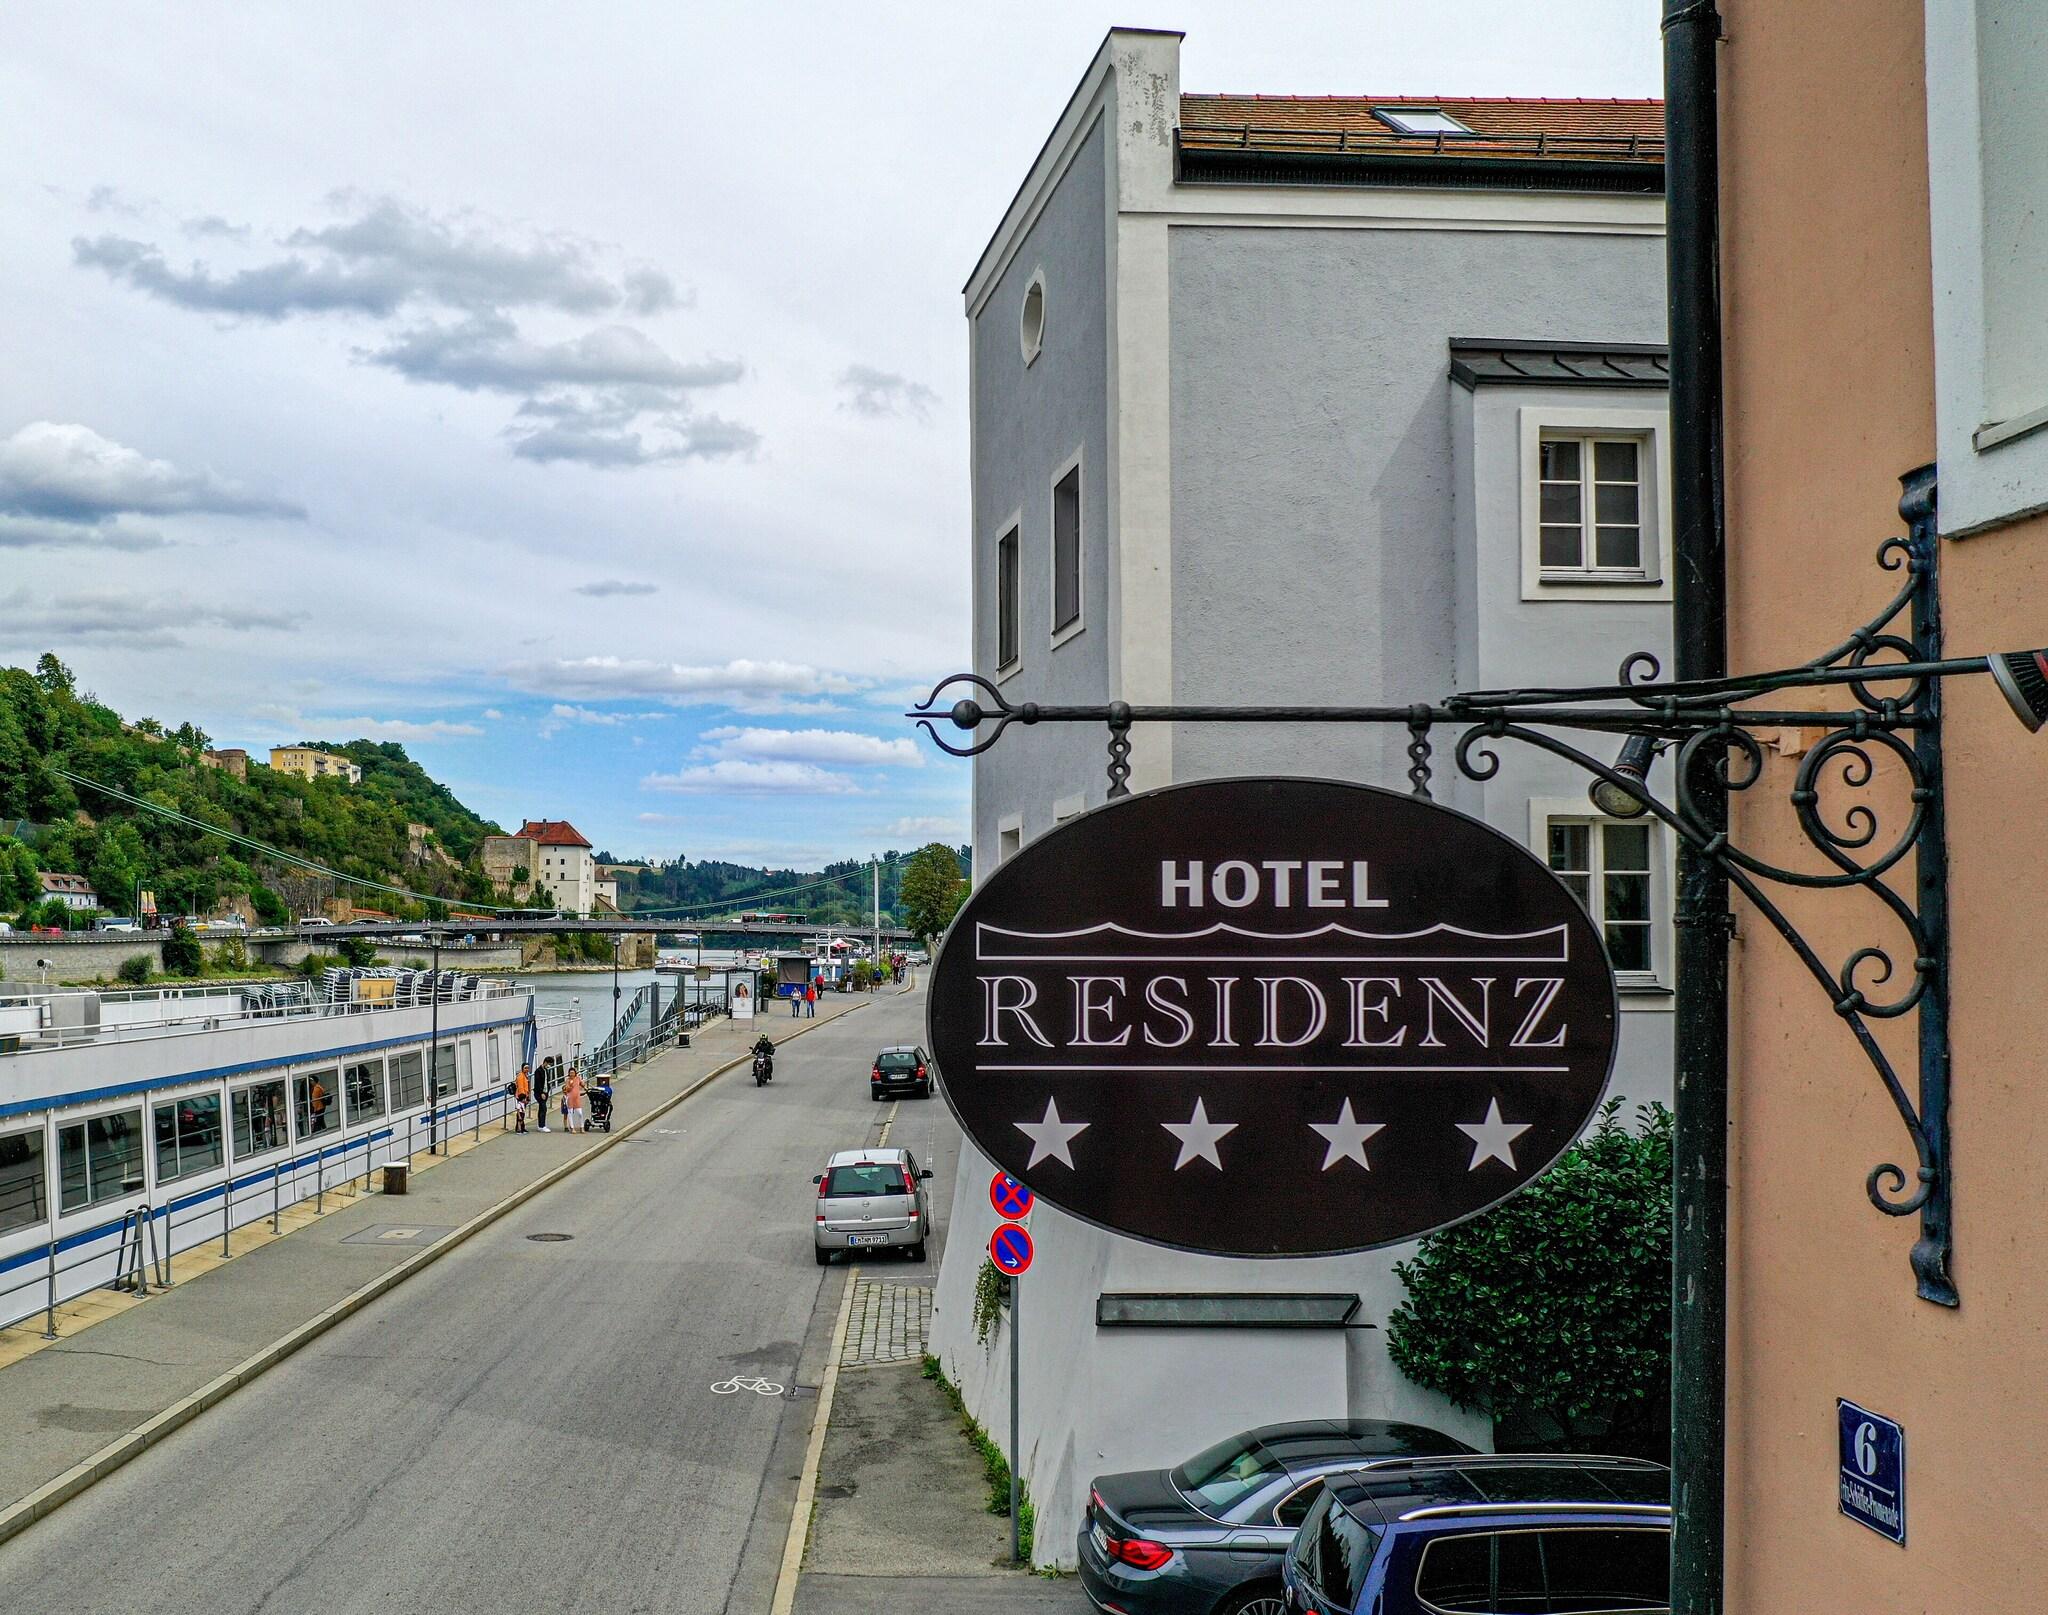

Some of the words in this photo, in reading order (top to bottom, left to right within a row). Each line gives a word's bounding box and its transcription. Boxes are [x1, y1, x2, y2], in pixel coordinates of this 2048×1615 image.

[1161, 860, 1390, 908] HOTEL
[975, 975, 1569, 1049] RESIDENZ
[1854, 1422, 1876, 1475] 6
